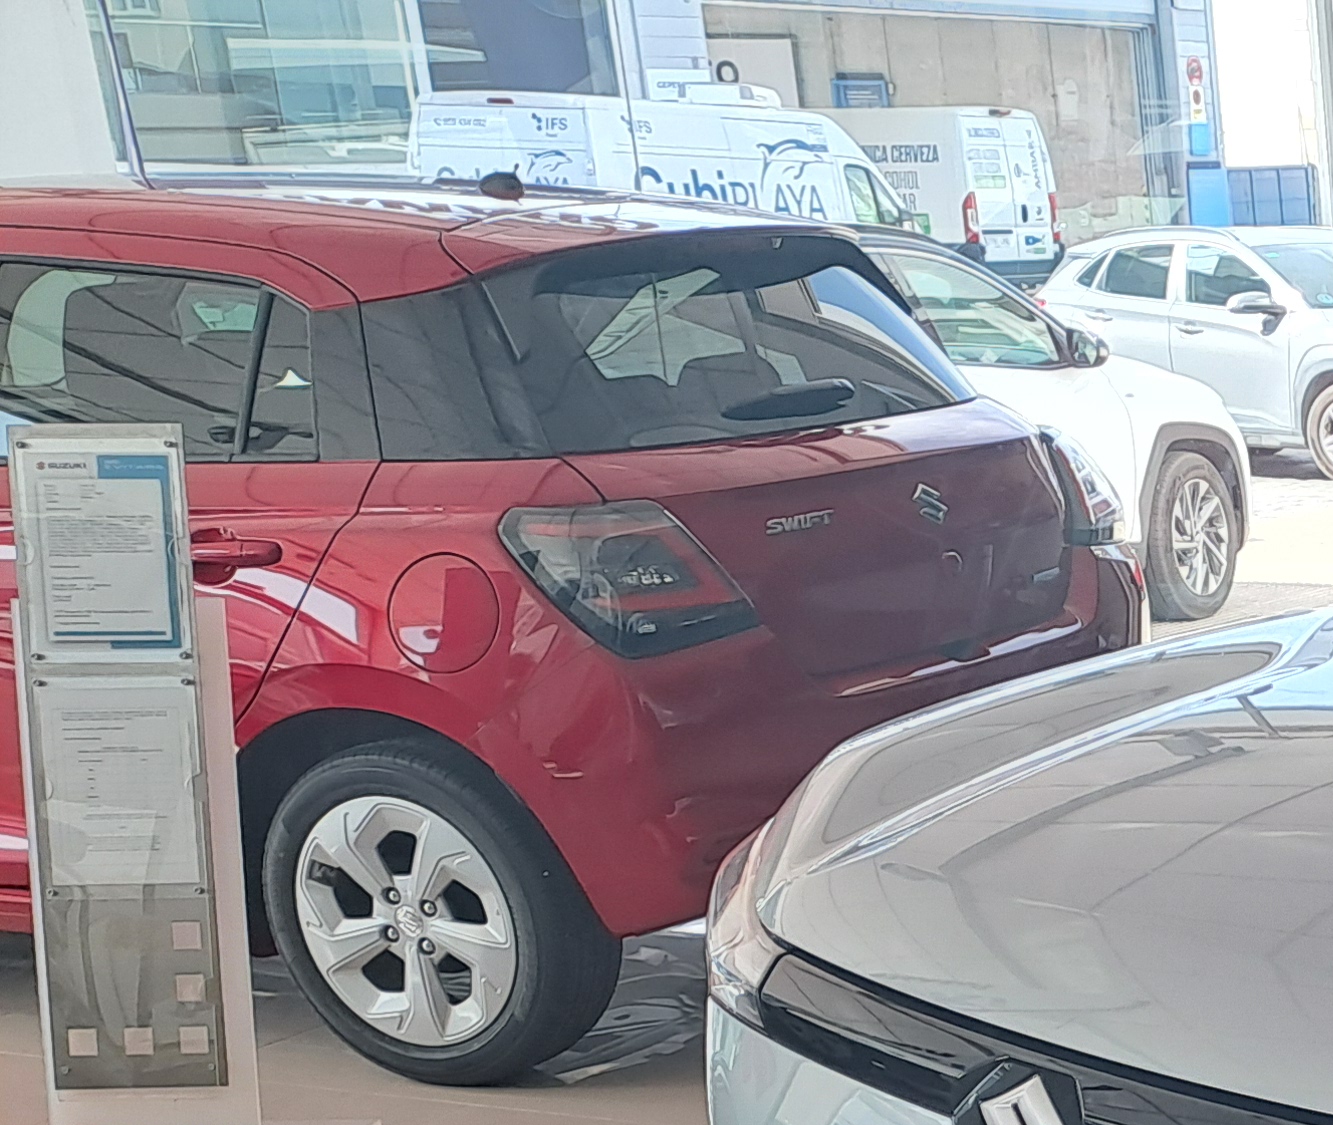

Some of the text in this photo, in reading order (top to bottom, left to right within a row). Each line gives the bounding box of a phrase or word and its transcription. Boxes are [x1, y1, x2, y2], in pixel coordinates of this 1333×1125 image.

[545, 117, 568, 131] IFS
[891, 144, 939, 163] CERVEZA
[766, 509, 835, 535] SWIFT
